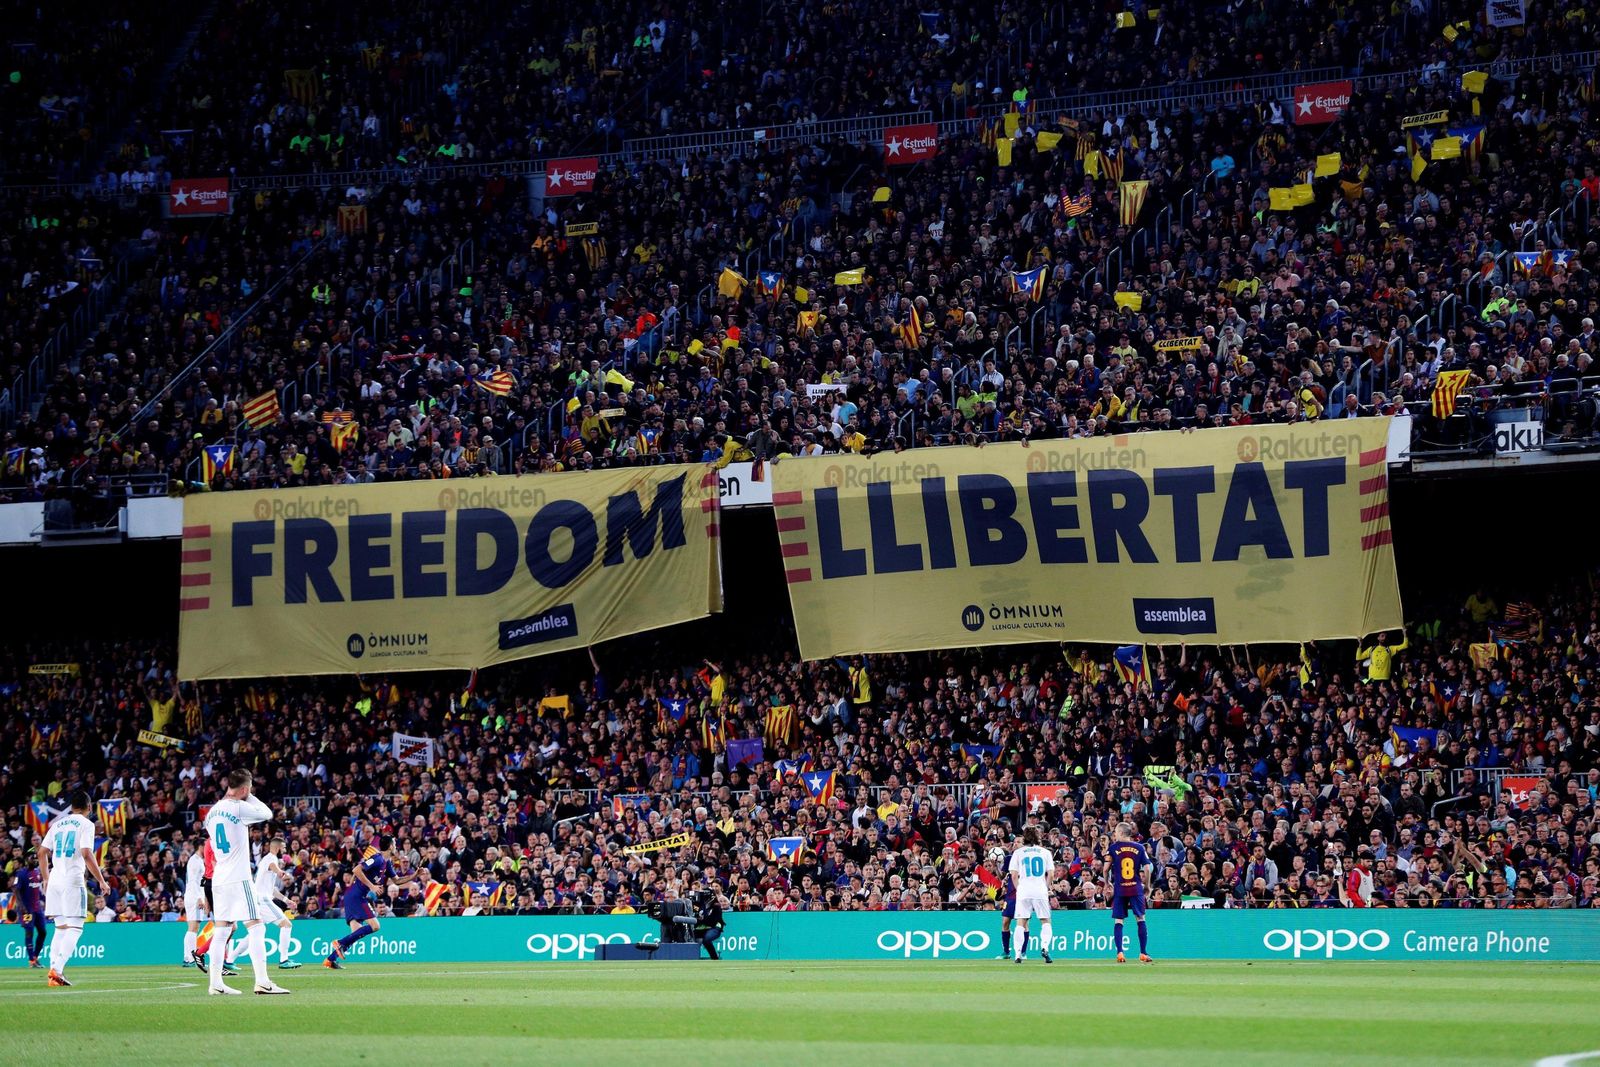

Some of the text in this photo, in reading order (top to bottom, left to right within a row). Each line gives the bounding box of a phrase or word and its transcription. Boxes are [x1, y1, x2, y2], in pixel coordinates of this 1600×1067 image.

[1315, 94, 1350, 107] Estrella
[1403, 111, 1444, 124] LLIBERTAT
[903, 136, 936, 148] Estrella
[564, 169, 596, 182] Estrella
[191, 189, 227, 200] Estrella
[568, 223, 595, 232] LLIBERTAT
[1158, 338, 1197, 349] LLIBERTAT
[1260, 432, 1362, 461] Rakuten
[1047, 446, 1146, 472] Rakuten
[845, 460, 940, 488] Rakuten
[456, 485, 546, 509] Rakuten
[272, 496, 359, 519] Rakuten
[814, 456, 1346, 580] LLIBERTAT
[232, 470, 687, 607] FREEDOM
[989, 603, 1063, 619] ÒMNIUM
[1144, 607, 1206, 622] assemblea
[507, 615, 569, 639] assemblea
[368, 632, 428, 648] ÒMNIUM
[400, 744, 427, 755] PROS
[55, 831, 76, 858] 14
[215, 823, 230, 853] 4
[629, 835, 686, 850] LIBERTAT
[1022, 856, 1044, 877] 10
[1121, 857, 1135, 880] 8
[371, 935, 416, 955] Phone
[717, 934, 758, 951] hone
[877, 930, 990, 958] oppo
[1263, 929, 1549, 958] oppo Camera Phone
